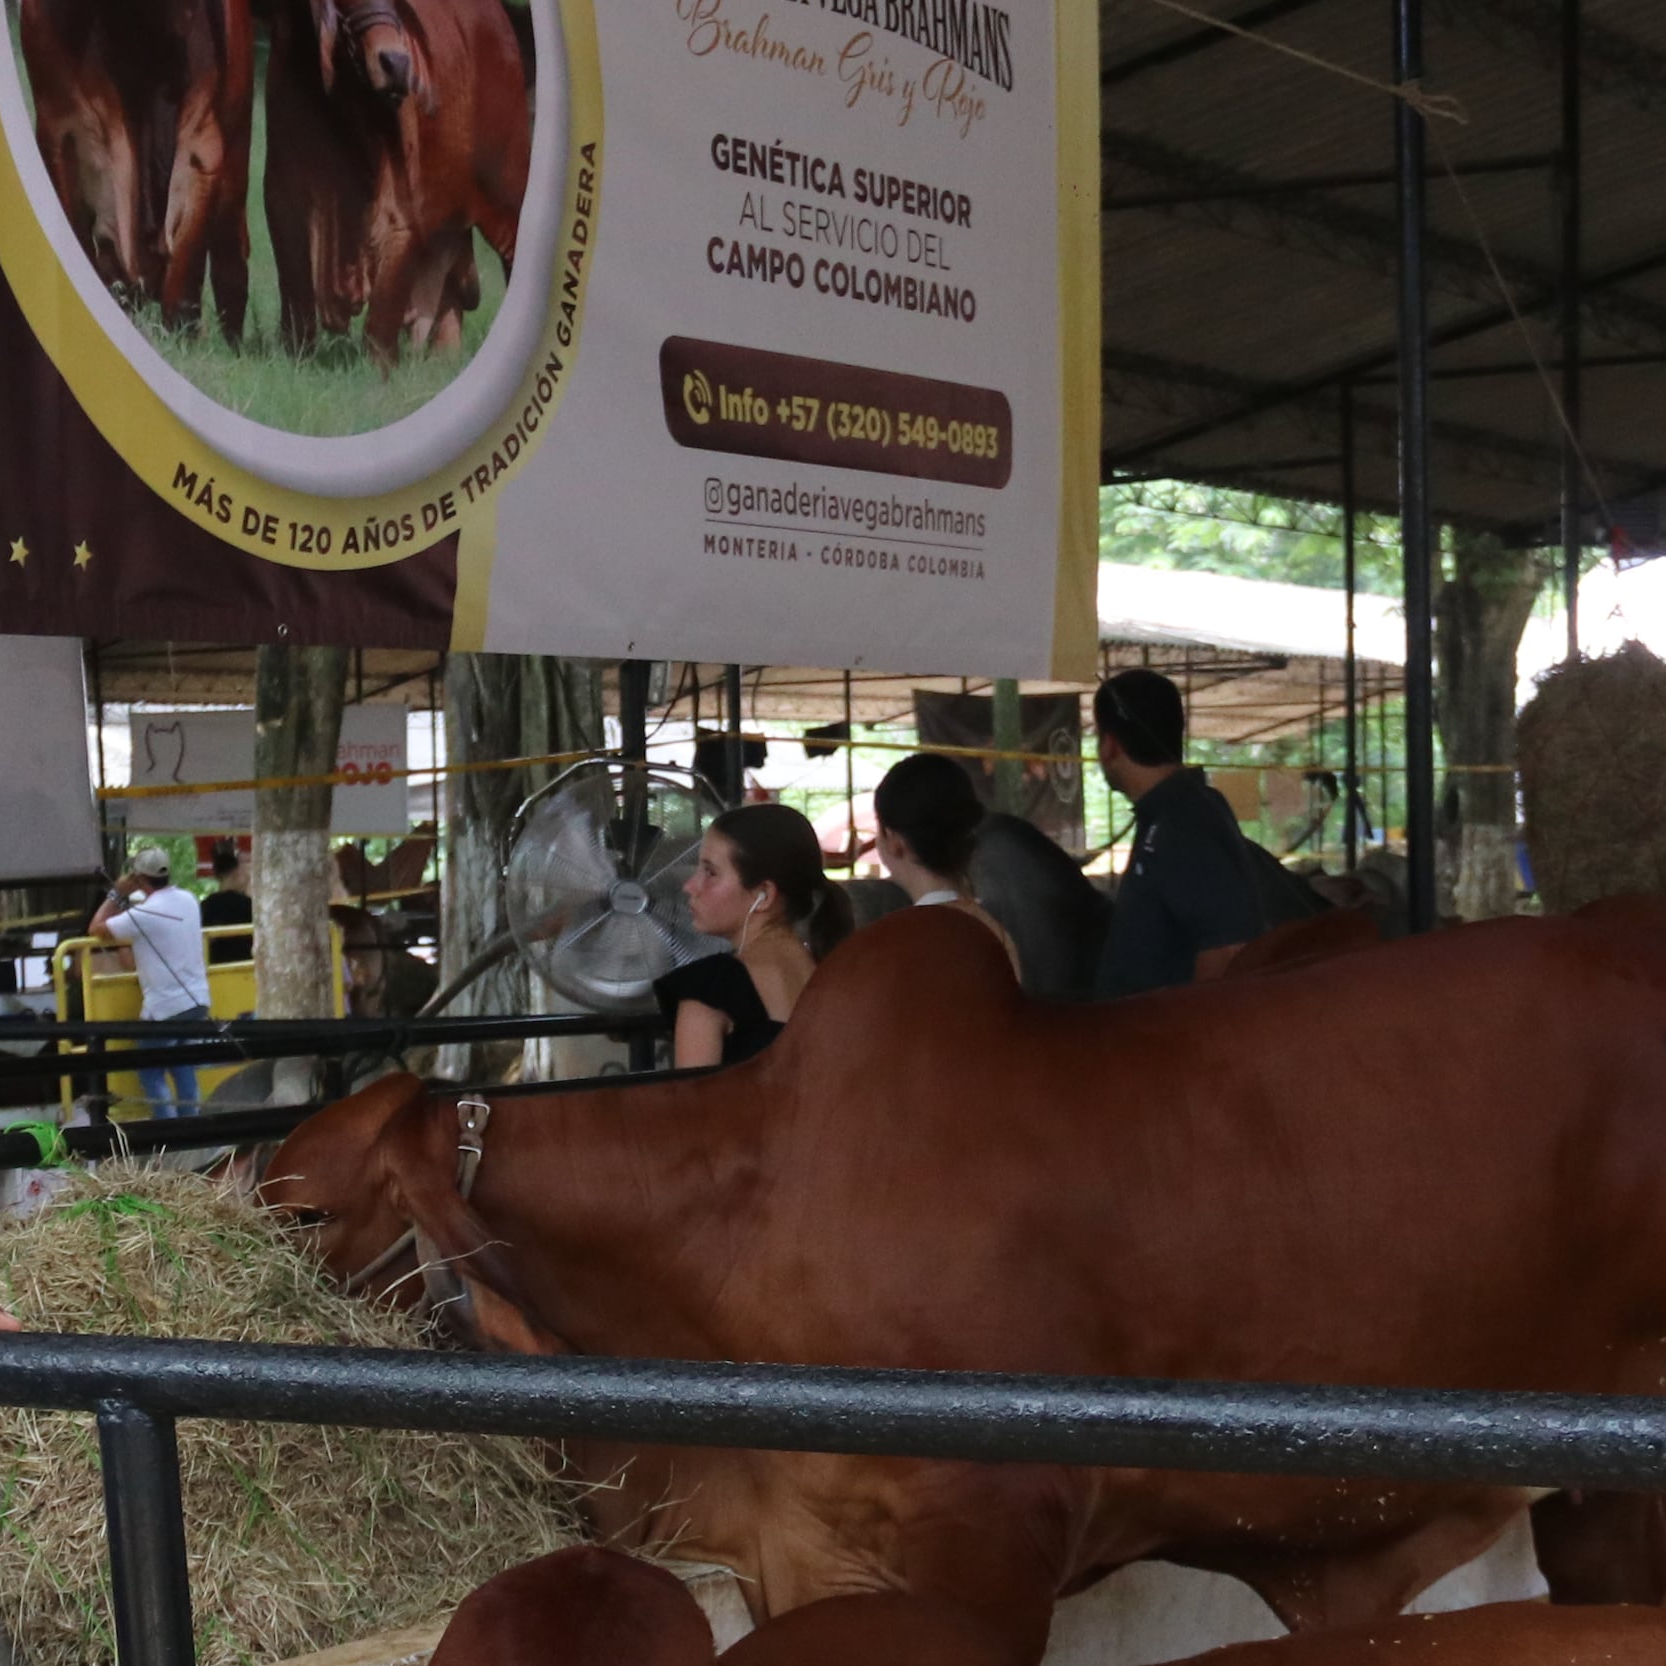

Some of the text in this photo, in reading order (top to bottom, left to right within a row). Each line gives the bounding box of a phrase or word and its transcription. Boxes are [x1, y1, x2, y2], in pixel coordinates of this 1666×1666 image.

[677, 0, 987, 139] Brahman Gris y Rojo
[711, 134, 971, 228] GENÉTICA SUPERIOR
[740, 191, 951, 271] AL SERVICIO DEL
[707, 236, 976, 323] CAMPO COLOMBIANO
[173, 141, 597, 556] MÁS DE 120 AÑOS DE TRADICIÓN GANADERA
[719, 384, 998, 459] Info +57 (320) 549-0893
[703, 534, 798, 562] MONTERIA
[820, 543, 900, 571] CÓRDOBA
[908, 554, 985, 580] COLOMBIA
